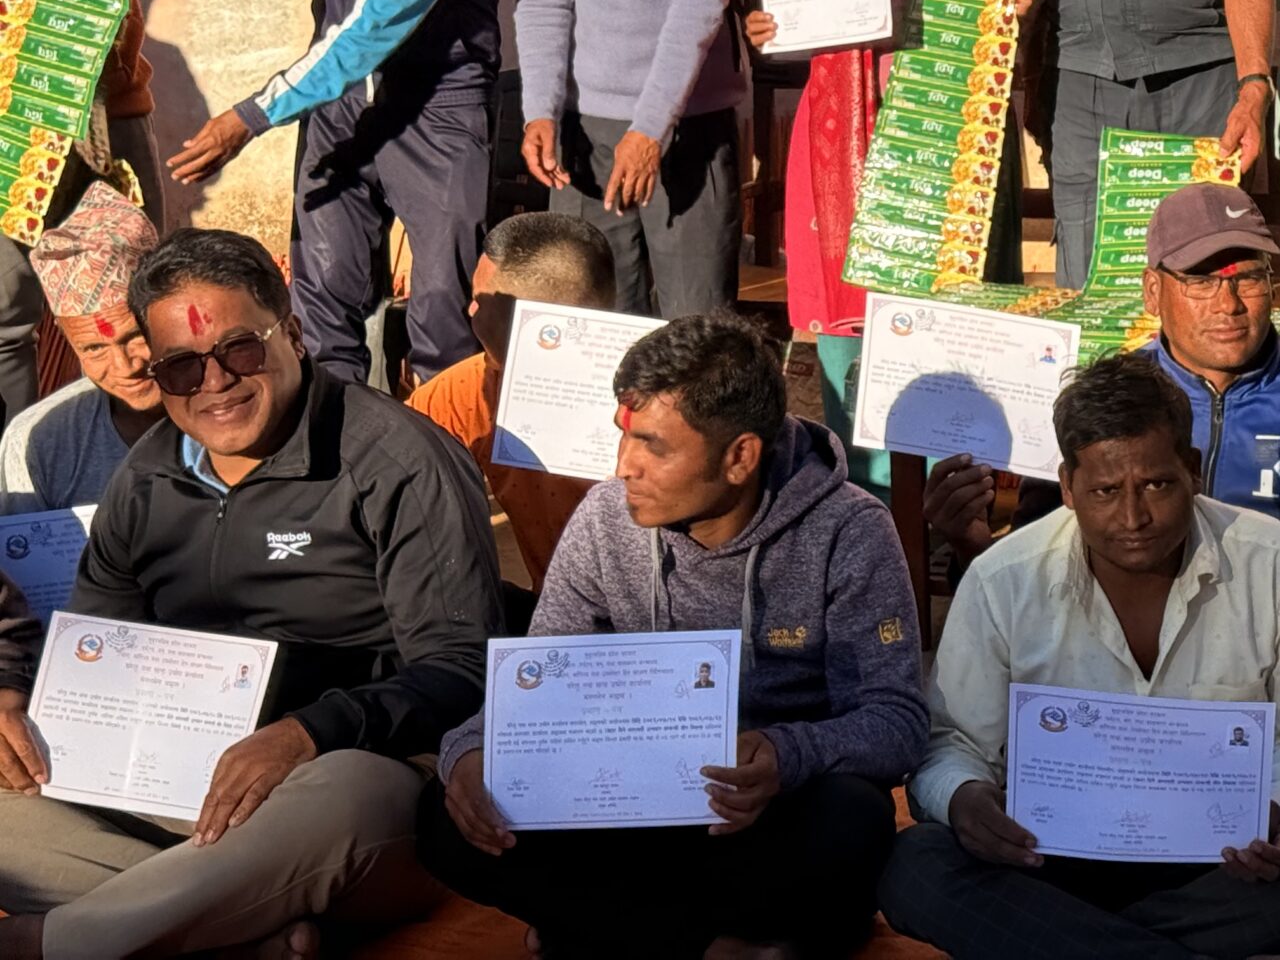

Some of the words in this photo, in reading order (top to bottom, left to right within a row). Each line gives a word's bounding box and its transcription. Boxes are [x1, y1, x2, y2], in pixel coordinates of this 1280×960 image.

[1128, 168, 1162, 179] Deep
[1126, 197, 1160, 208] Deep
[1124, 227, 1148, 237] eep
[267, 531, 312, 545] Reebok
